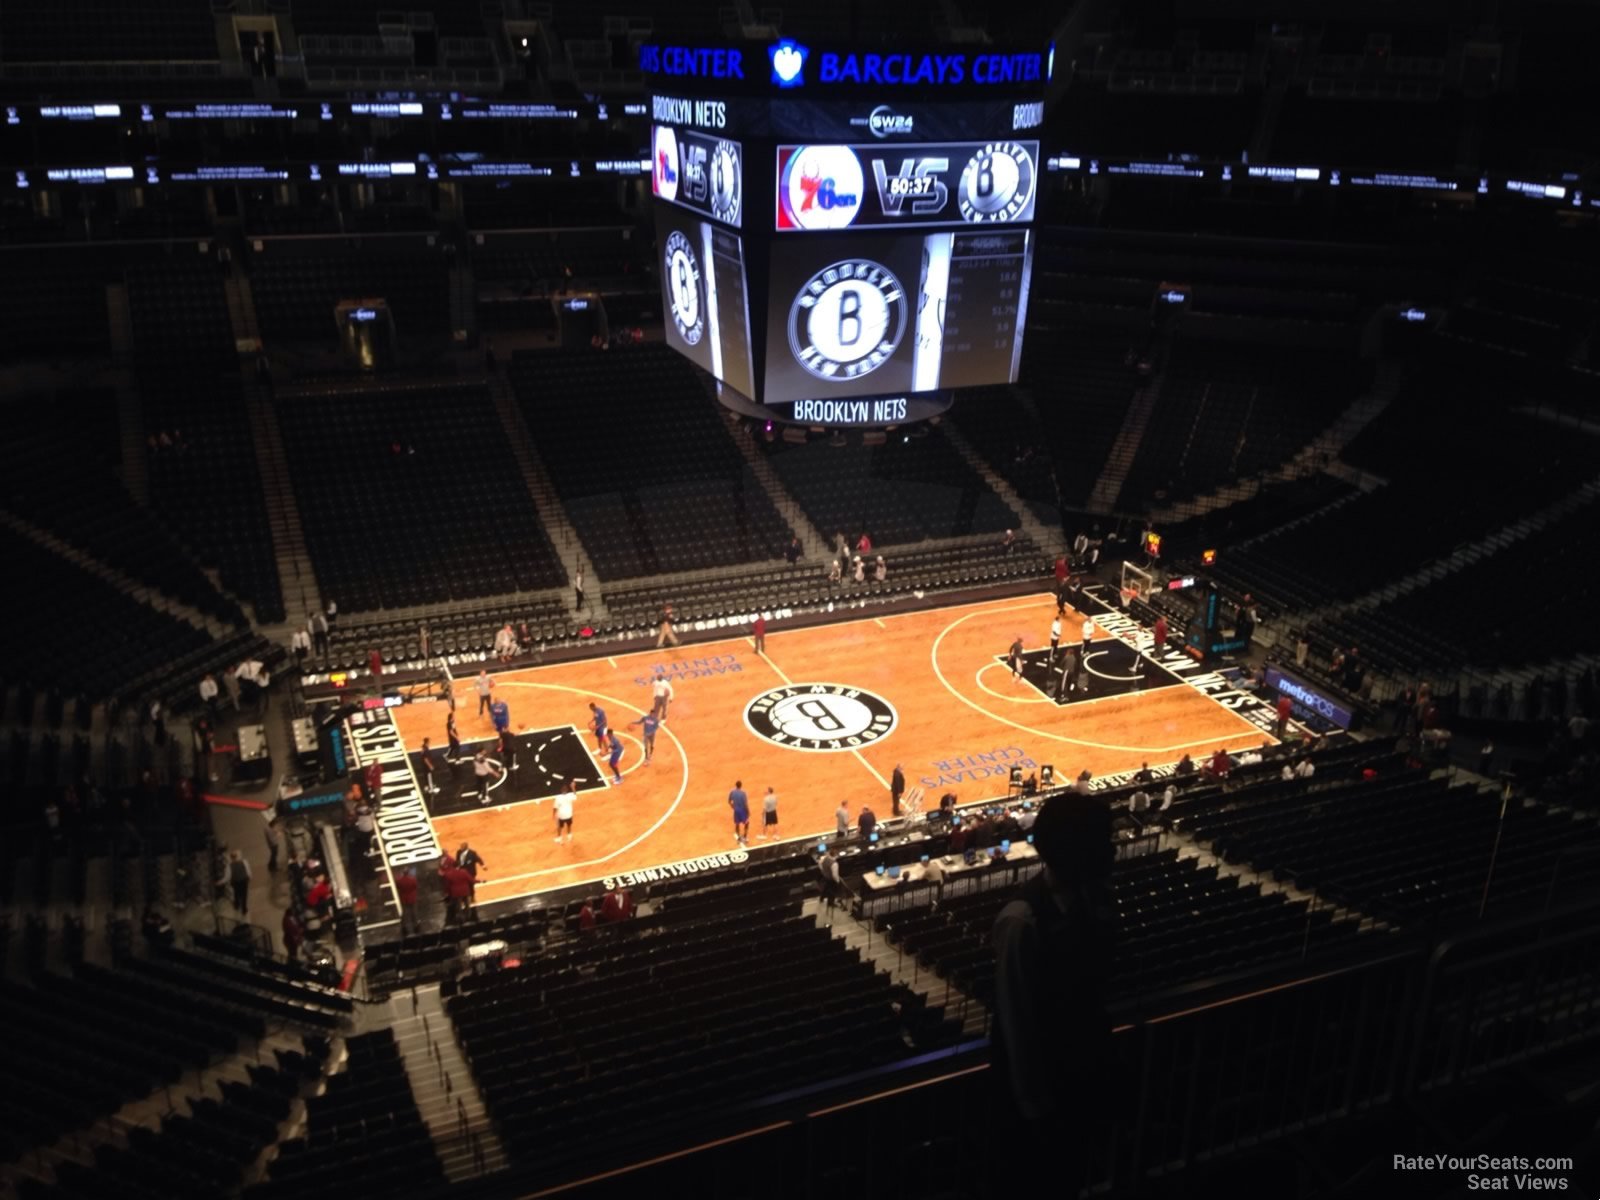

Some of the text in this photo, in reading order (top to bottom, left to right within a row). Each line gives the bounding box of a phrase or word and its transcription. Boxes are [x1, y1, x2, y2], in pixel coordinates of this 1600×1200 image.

[662, 46, 744, 79] CENTER
[819, 52, 1041, 84] BARCLAYS CENTER
[652, 94, 726, 128] BROOKLYN NETS
[798, 263, 901, 309] BROOKLYN
[838, 289, 862, 346] B
[799, 339, 896, 377] NEW YORK
[794, 398, 907, 423] BROOKLYN NETS
[811, 685, 861, 699] NEW
[1279, 678, 1335, 717] metroPCS
[352, 723, 405, 768] NETS
[932, 745, 1025, 772] CENTER
[375, 768, 443, 867] BROOKLYN
[602, 851, 749, 891] @BROOKLYNNETS
